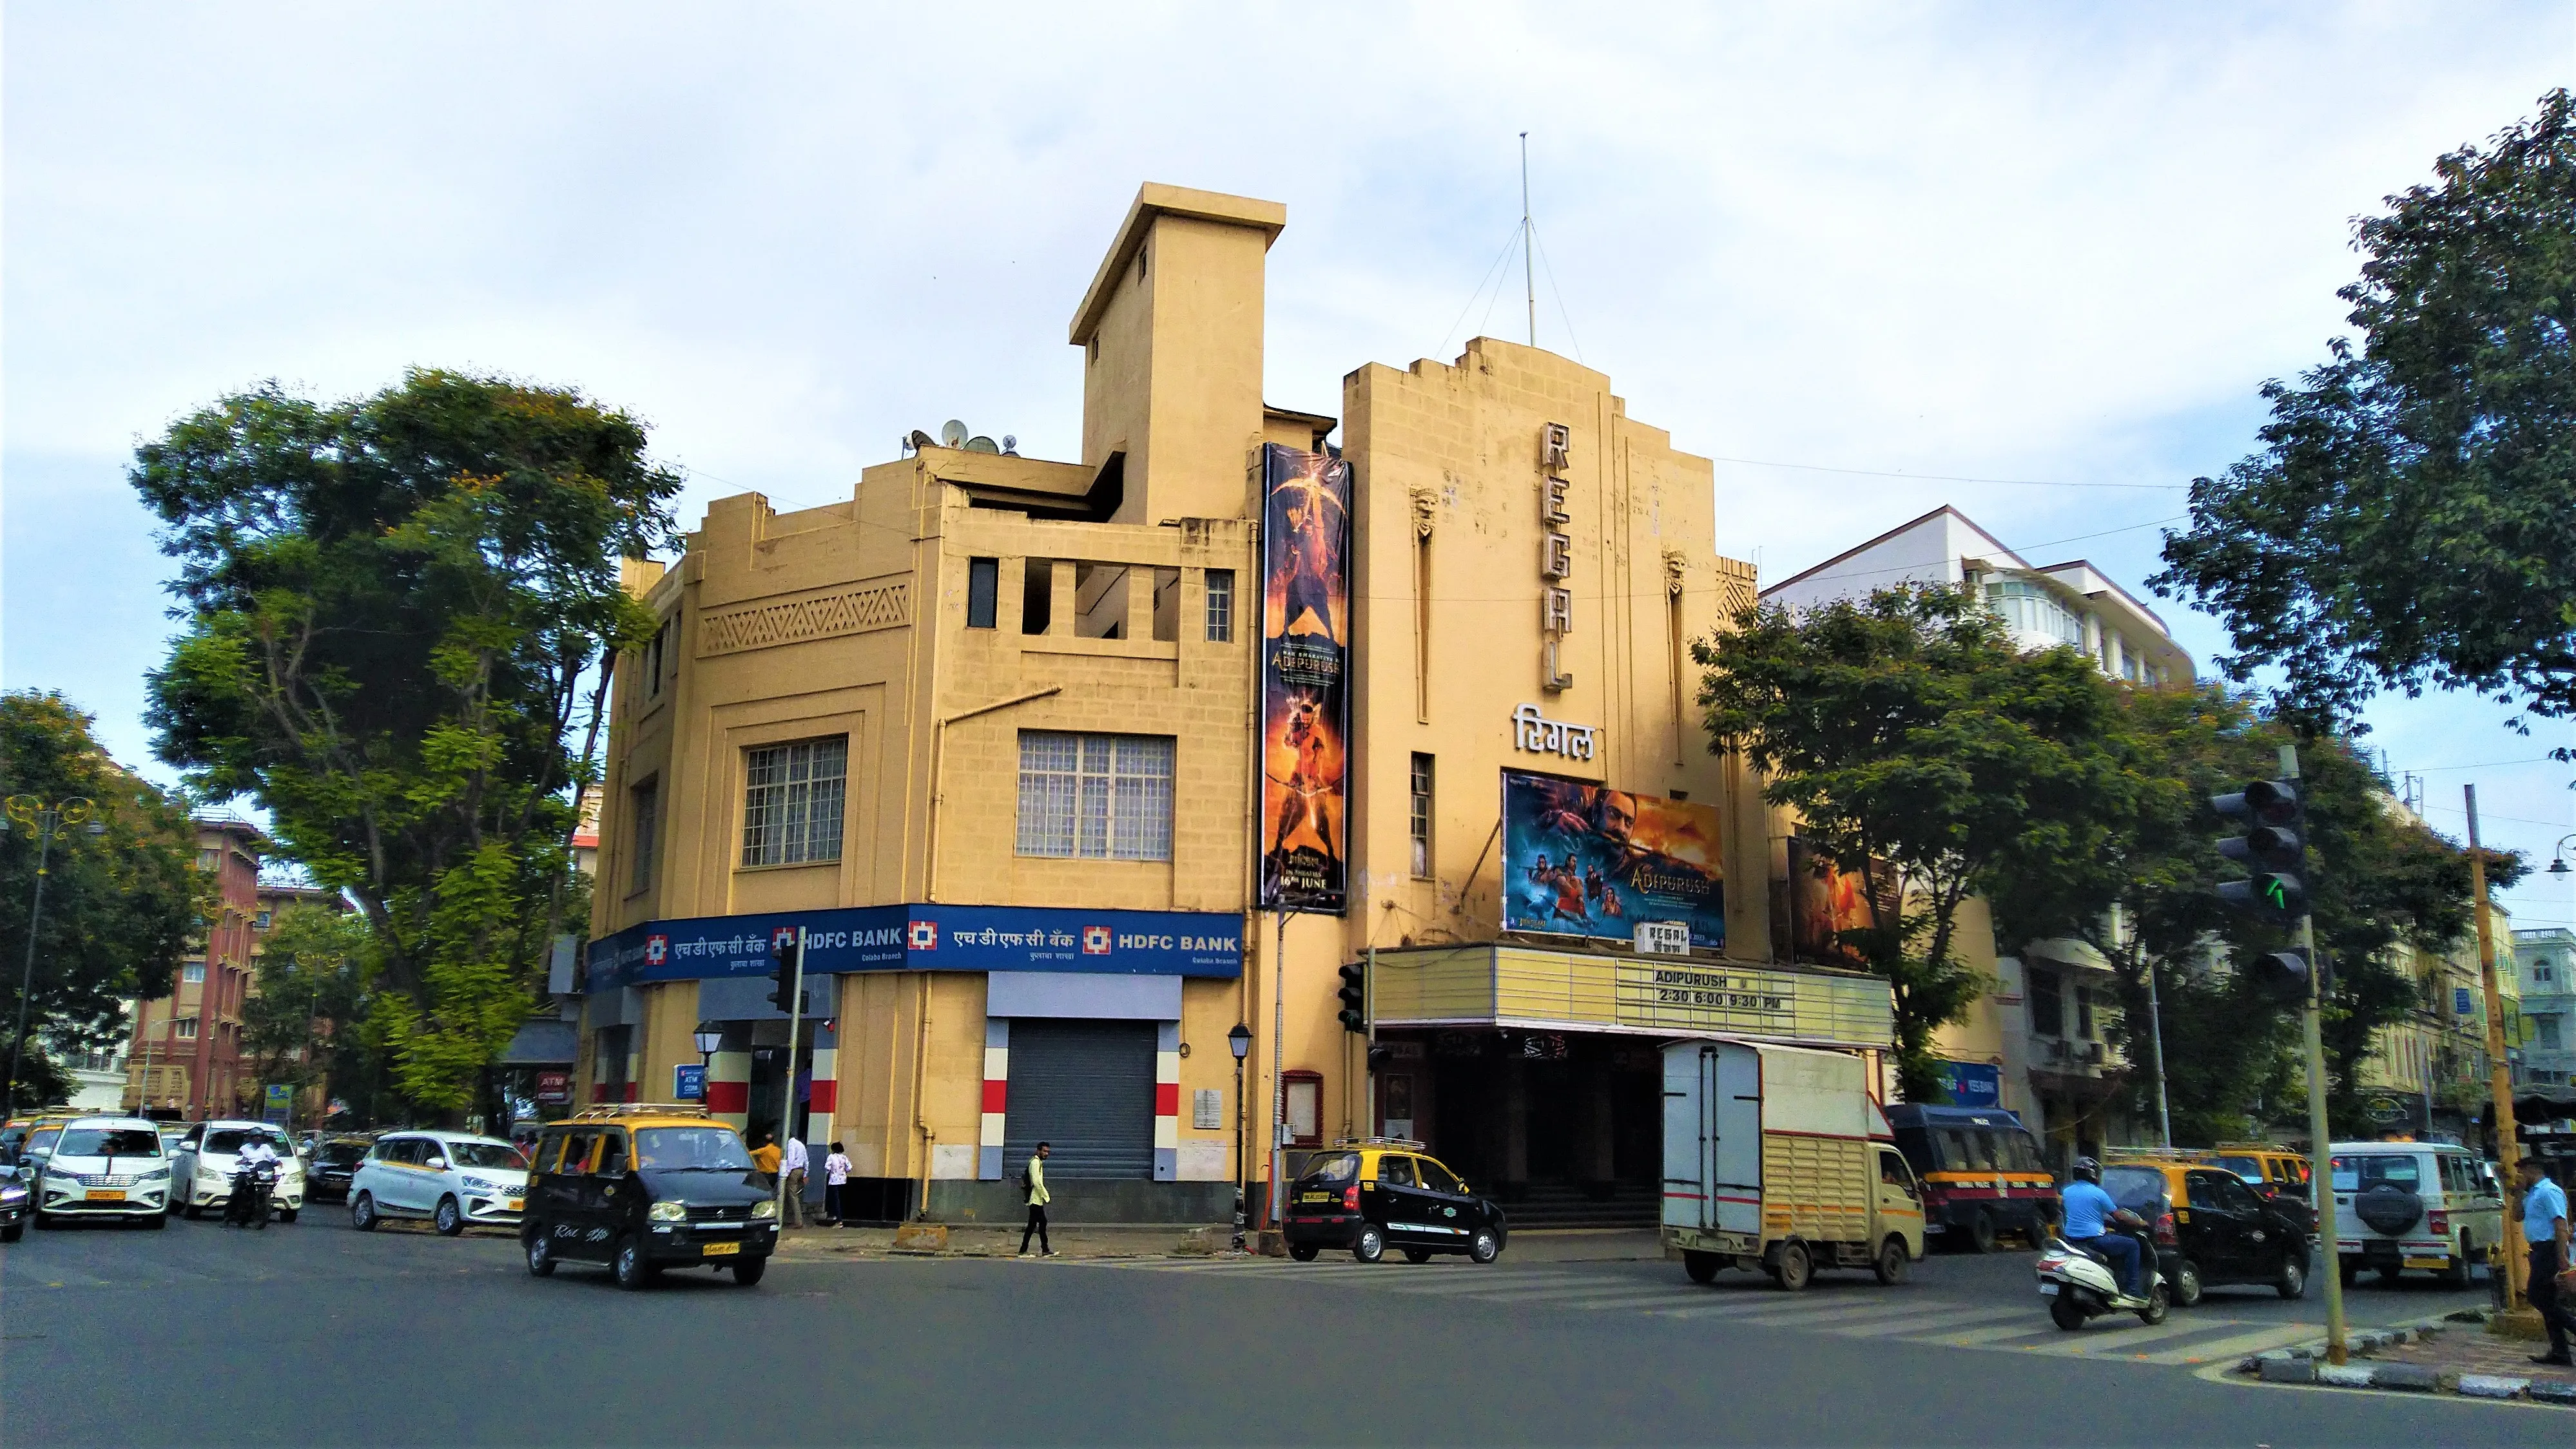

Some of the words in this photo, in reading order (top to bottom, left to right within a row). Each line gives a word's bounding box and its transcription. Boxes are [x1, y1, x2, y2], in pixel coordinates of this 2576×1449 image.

[1542, 422, 1573, 691] REGAL
[1272, 651, 1340, 674] ADIPURUSH
[1513, 703, 1596, 759] रिगल
[1301, 877, 1326, 889] JUNE
[1630, 867, 1710, 894] ADIPURUSH
[805, 932, 847, 950] HDFC
[852, 928, 902, 947] BANK
[1119, 934, 1174, 950] HDFC
[1180, 936, 1237, 952] BANK
[1649, 927, 1687, 942] REGAL
[862, 954, 880, 962] Colaba
[882, 952, 902, 961] Branch
[1656, 970, 1727, 987] ADIPURUSH
[1660, 990, 1689, 1003] 2:30
[1696, 993, 1723, 1005] 6:00
[1730, 994, 1757, 1008] 9:30
[1765, 997, 1781, 1009] PM
